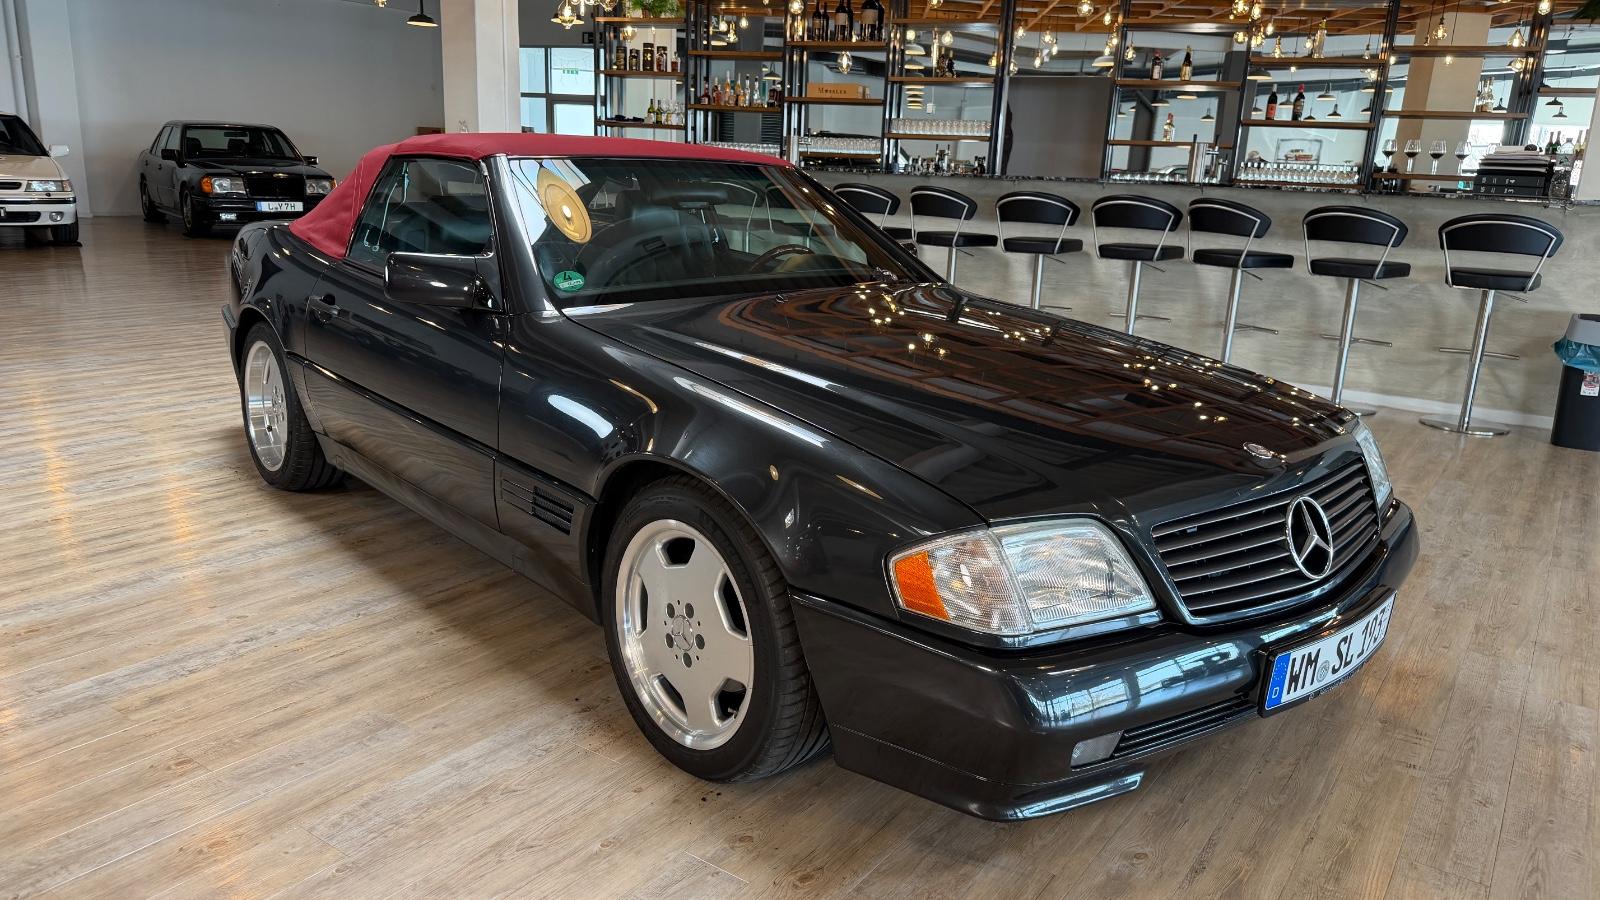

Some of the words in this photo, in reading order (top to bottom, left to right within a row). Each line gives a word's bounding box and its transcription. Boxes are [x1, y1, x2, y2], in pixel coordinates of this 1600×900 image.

[1287, 647, 1321, 695] WM
[1331, 632, 1354, 675] SL
[1271, 686, 1280, 699] D
